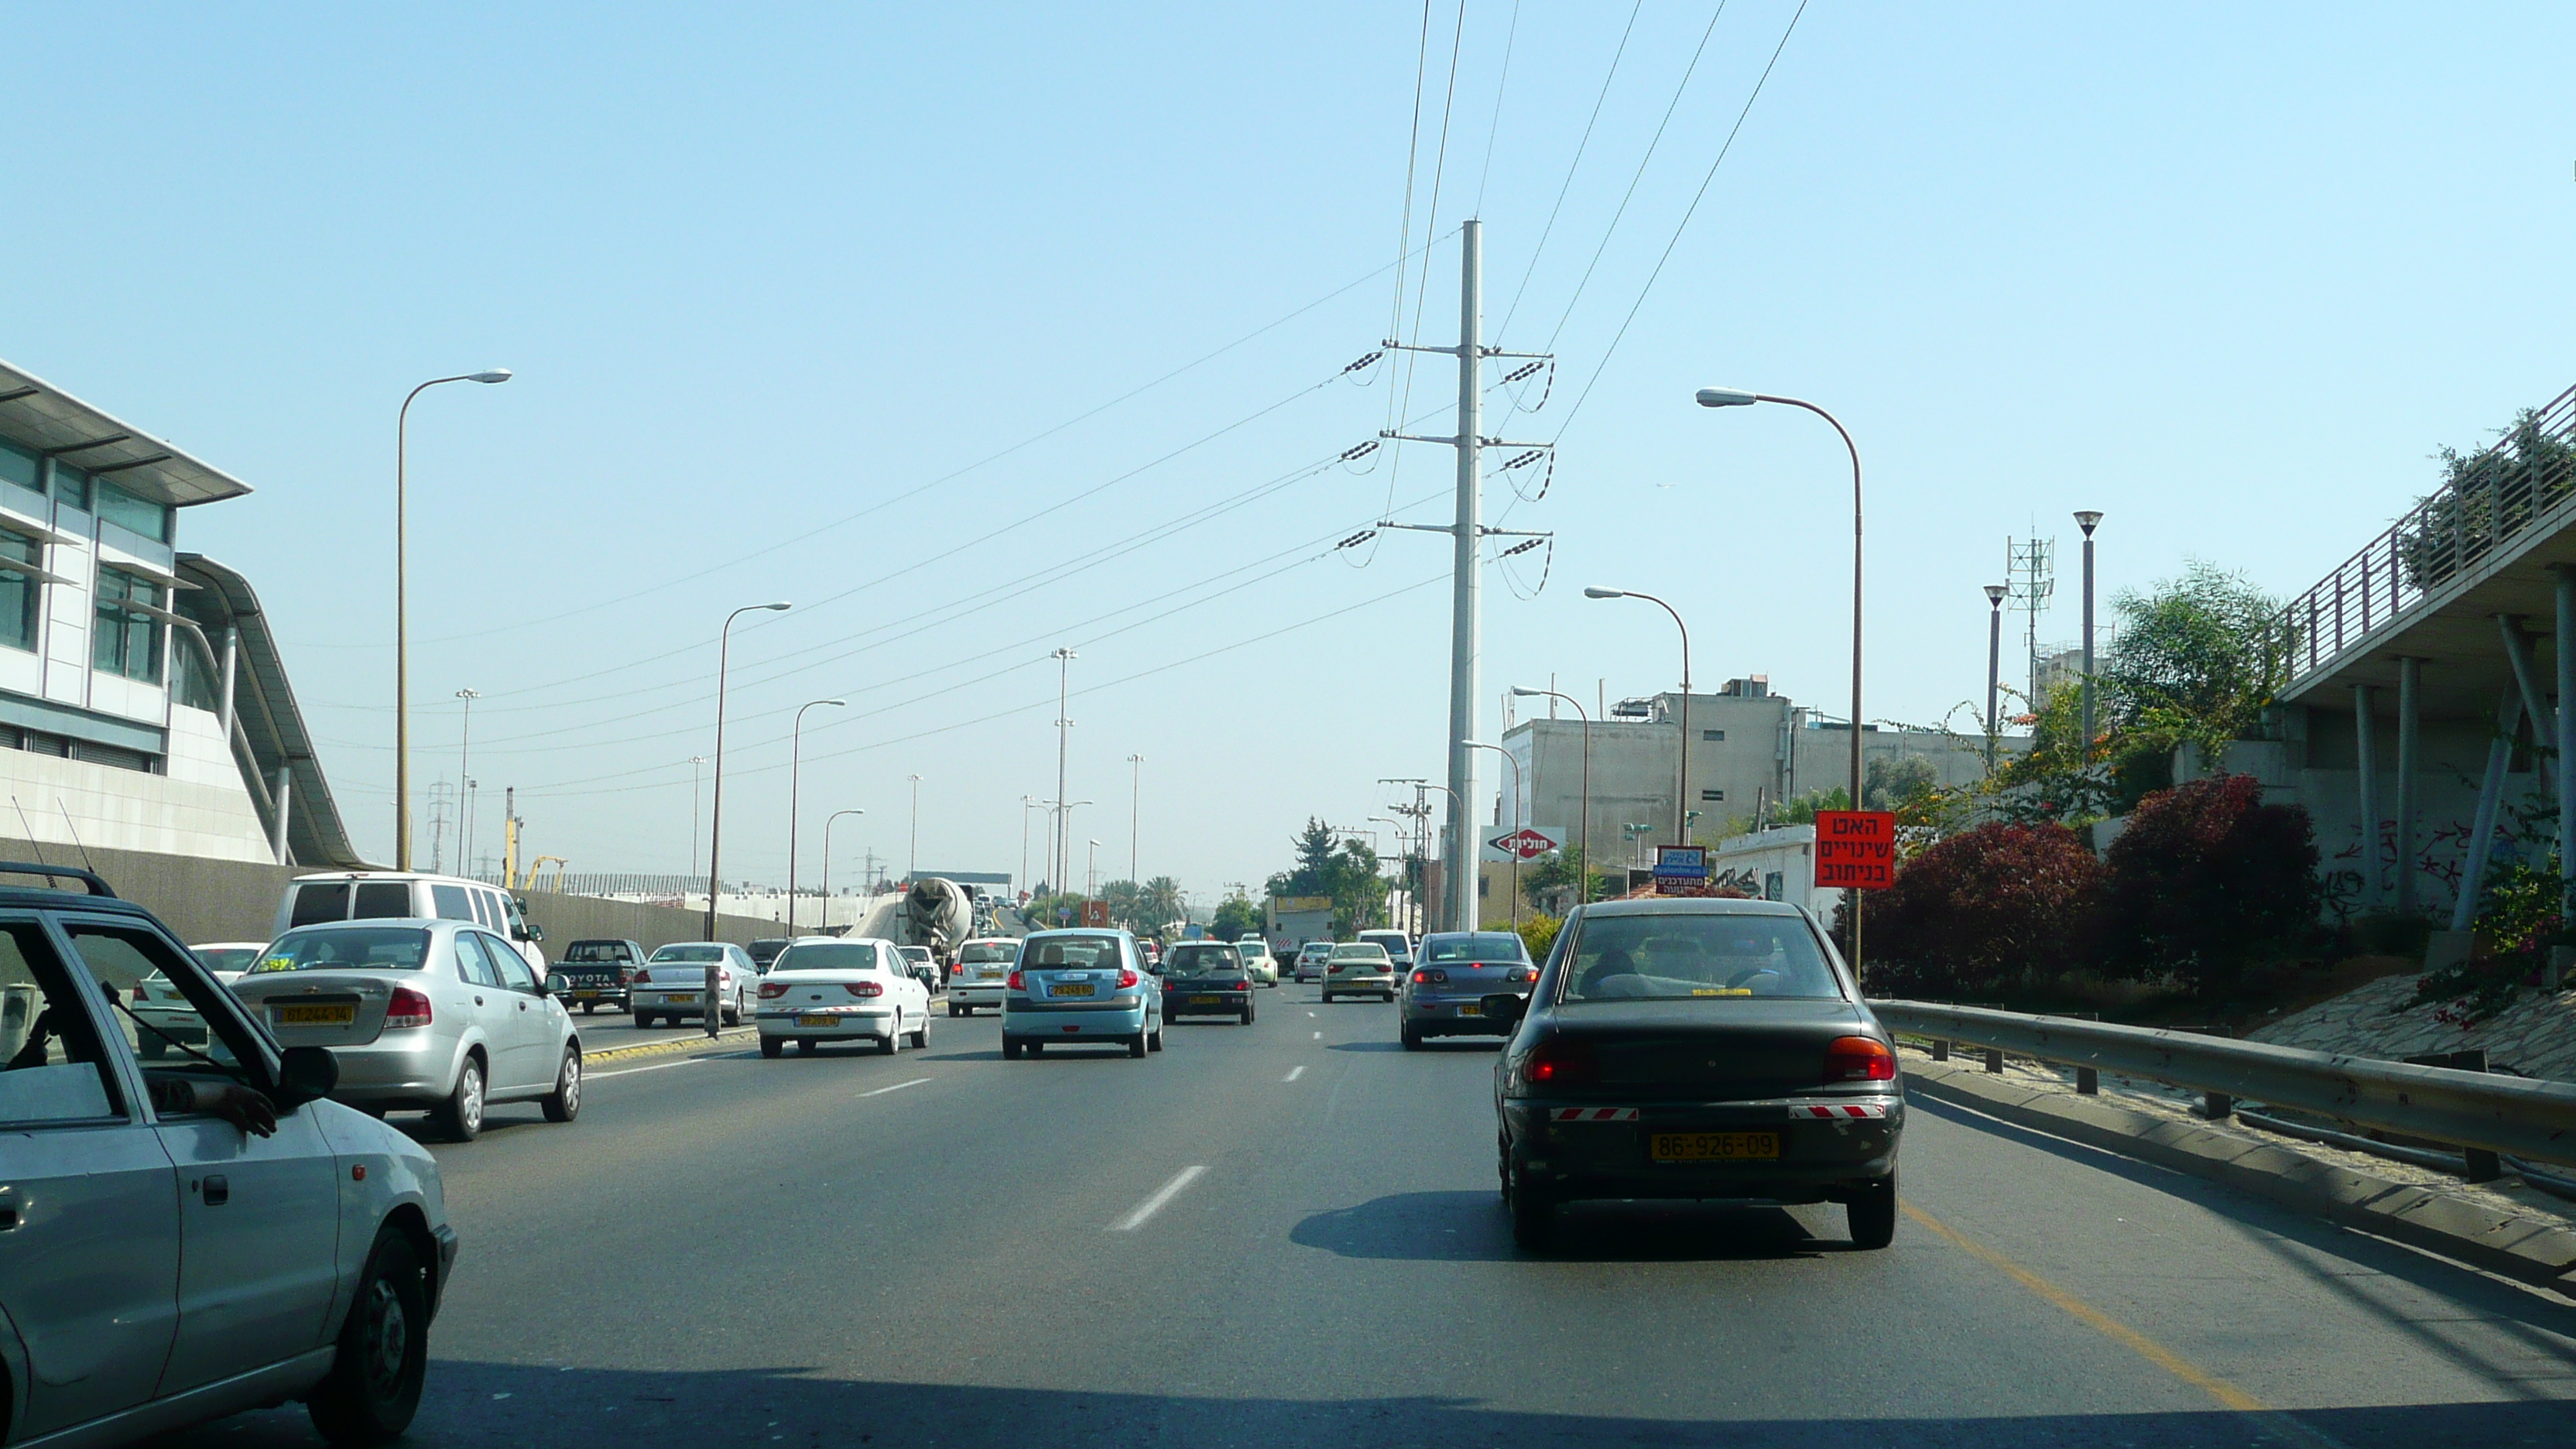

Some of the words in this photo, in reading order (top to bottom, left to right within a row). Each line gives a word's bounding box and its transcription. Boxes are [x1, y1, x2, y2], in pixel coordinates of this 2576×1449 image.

[1832, 817, 1879, 835] האט
[1820, 840, 1890, 858] שינויים
[1657, 876, 1704, 886] מתעדכנים
[569, 974, 610, 982] OYOTA
[1658, 1135, 1773, 1156] 86-926-09
